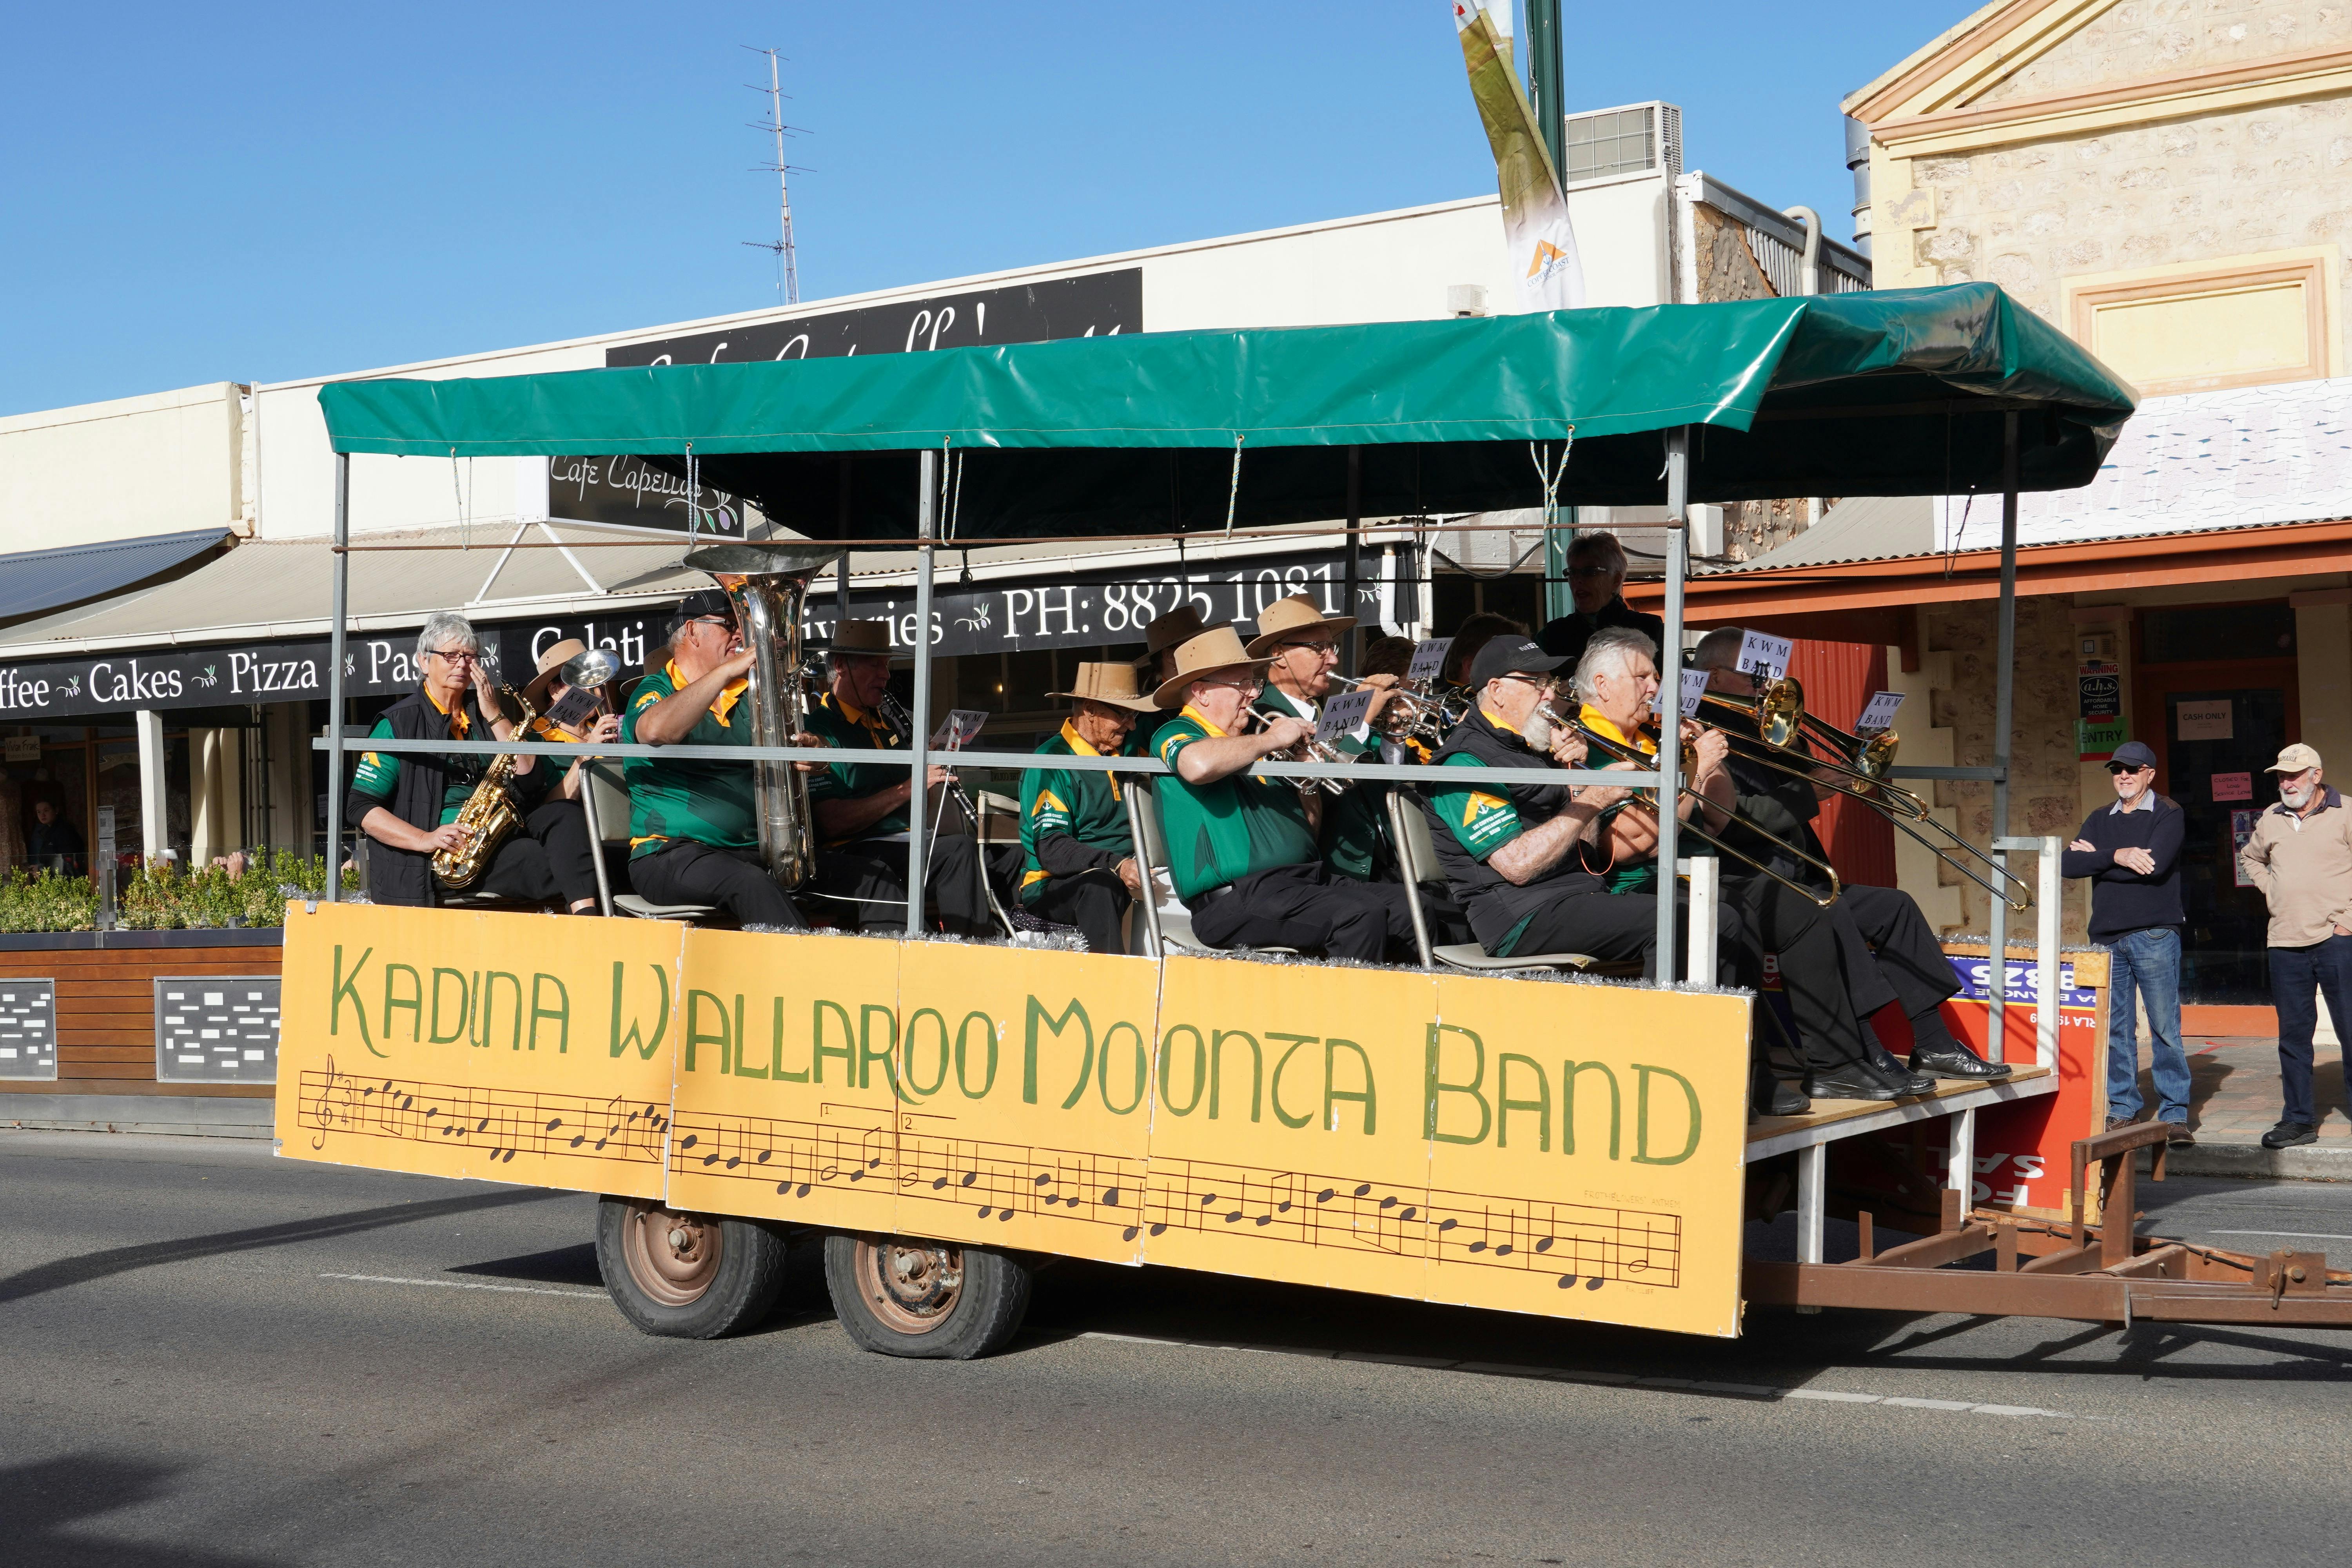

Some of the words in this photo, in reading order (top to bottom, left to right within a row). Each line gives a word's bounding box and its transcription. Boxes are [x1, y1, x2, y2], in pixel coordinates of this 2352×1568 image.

[1528, 269, 1548, 287] COPPE
[1549, 257, 1569, 272] COAST
[89, 659, 183, 703] Cakes
[228, 652, 319, 693] Pizza
[368, 642, 419, 684] Pas
[1002, 586, 1089, 638] PH:
[1104, 575, 1212, 631] 8825
[1227, 564, 1341, 621] 1081
[2084, 679, 2116, 691] a.h.s.
[1864, 715, 1891, 725] BAND
[2082, 730, 2123, 744] ENTRY
[1493, 809, 1506, 819] COAST
[331, 945, 570, 1058] KADINA
[610, 961, 998, 1105] WALLAROO
[1024, 994, 1377, 1136] MOONTA
[1423, 1022, 1702, 1165] BAND
[1651, 1198, 1681, 1209] ANTHEM
